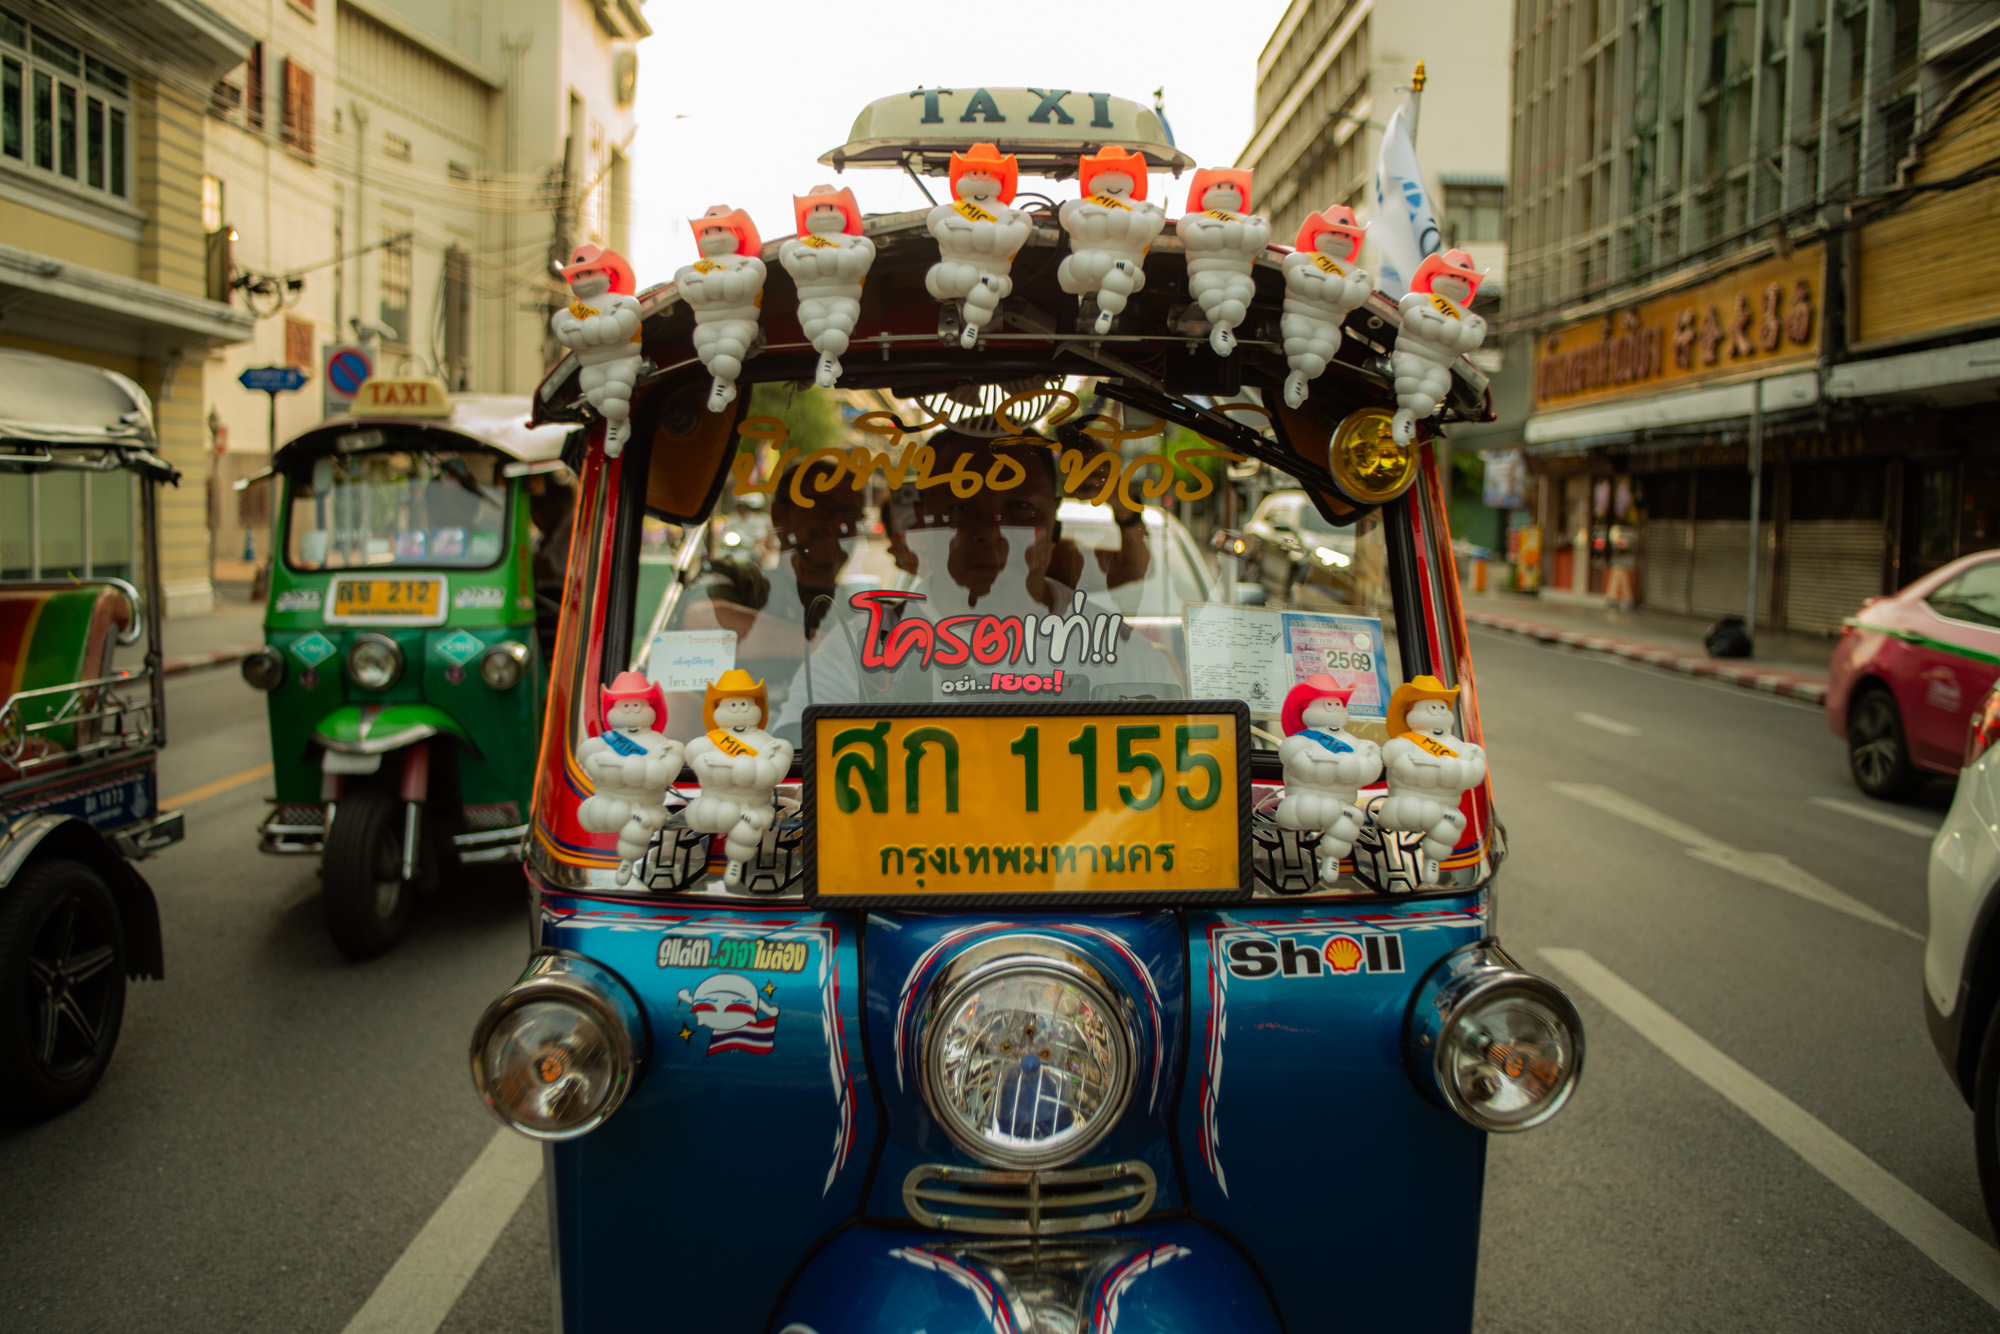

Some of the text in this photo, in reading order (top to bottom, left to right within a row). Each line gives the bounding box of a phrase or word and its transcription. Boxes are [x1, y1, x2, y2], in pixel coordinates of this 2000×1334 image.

[910, 87, 1114, 128] TAXI
[368, 382, 430, 406] TAXI
[387, 580, 431, 603] 212
[1325, 650, 1372, 672] 2569
[832, 720, 1222, 814] สก 1155
[879, 842, 1176, 888] กรุงเทพมหานคร
[1228, 934, 1404, 979] Shll
